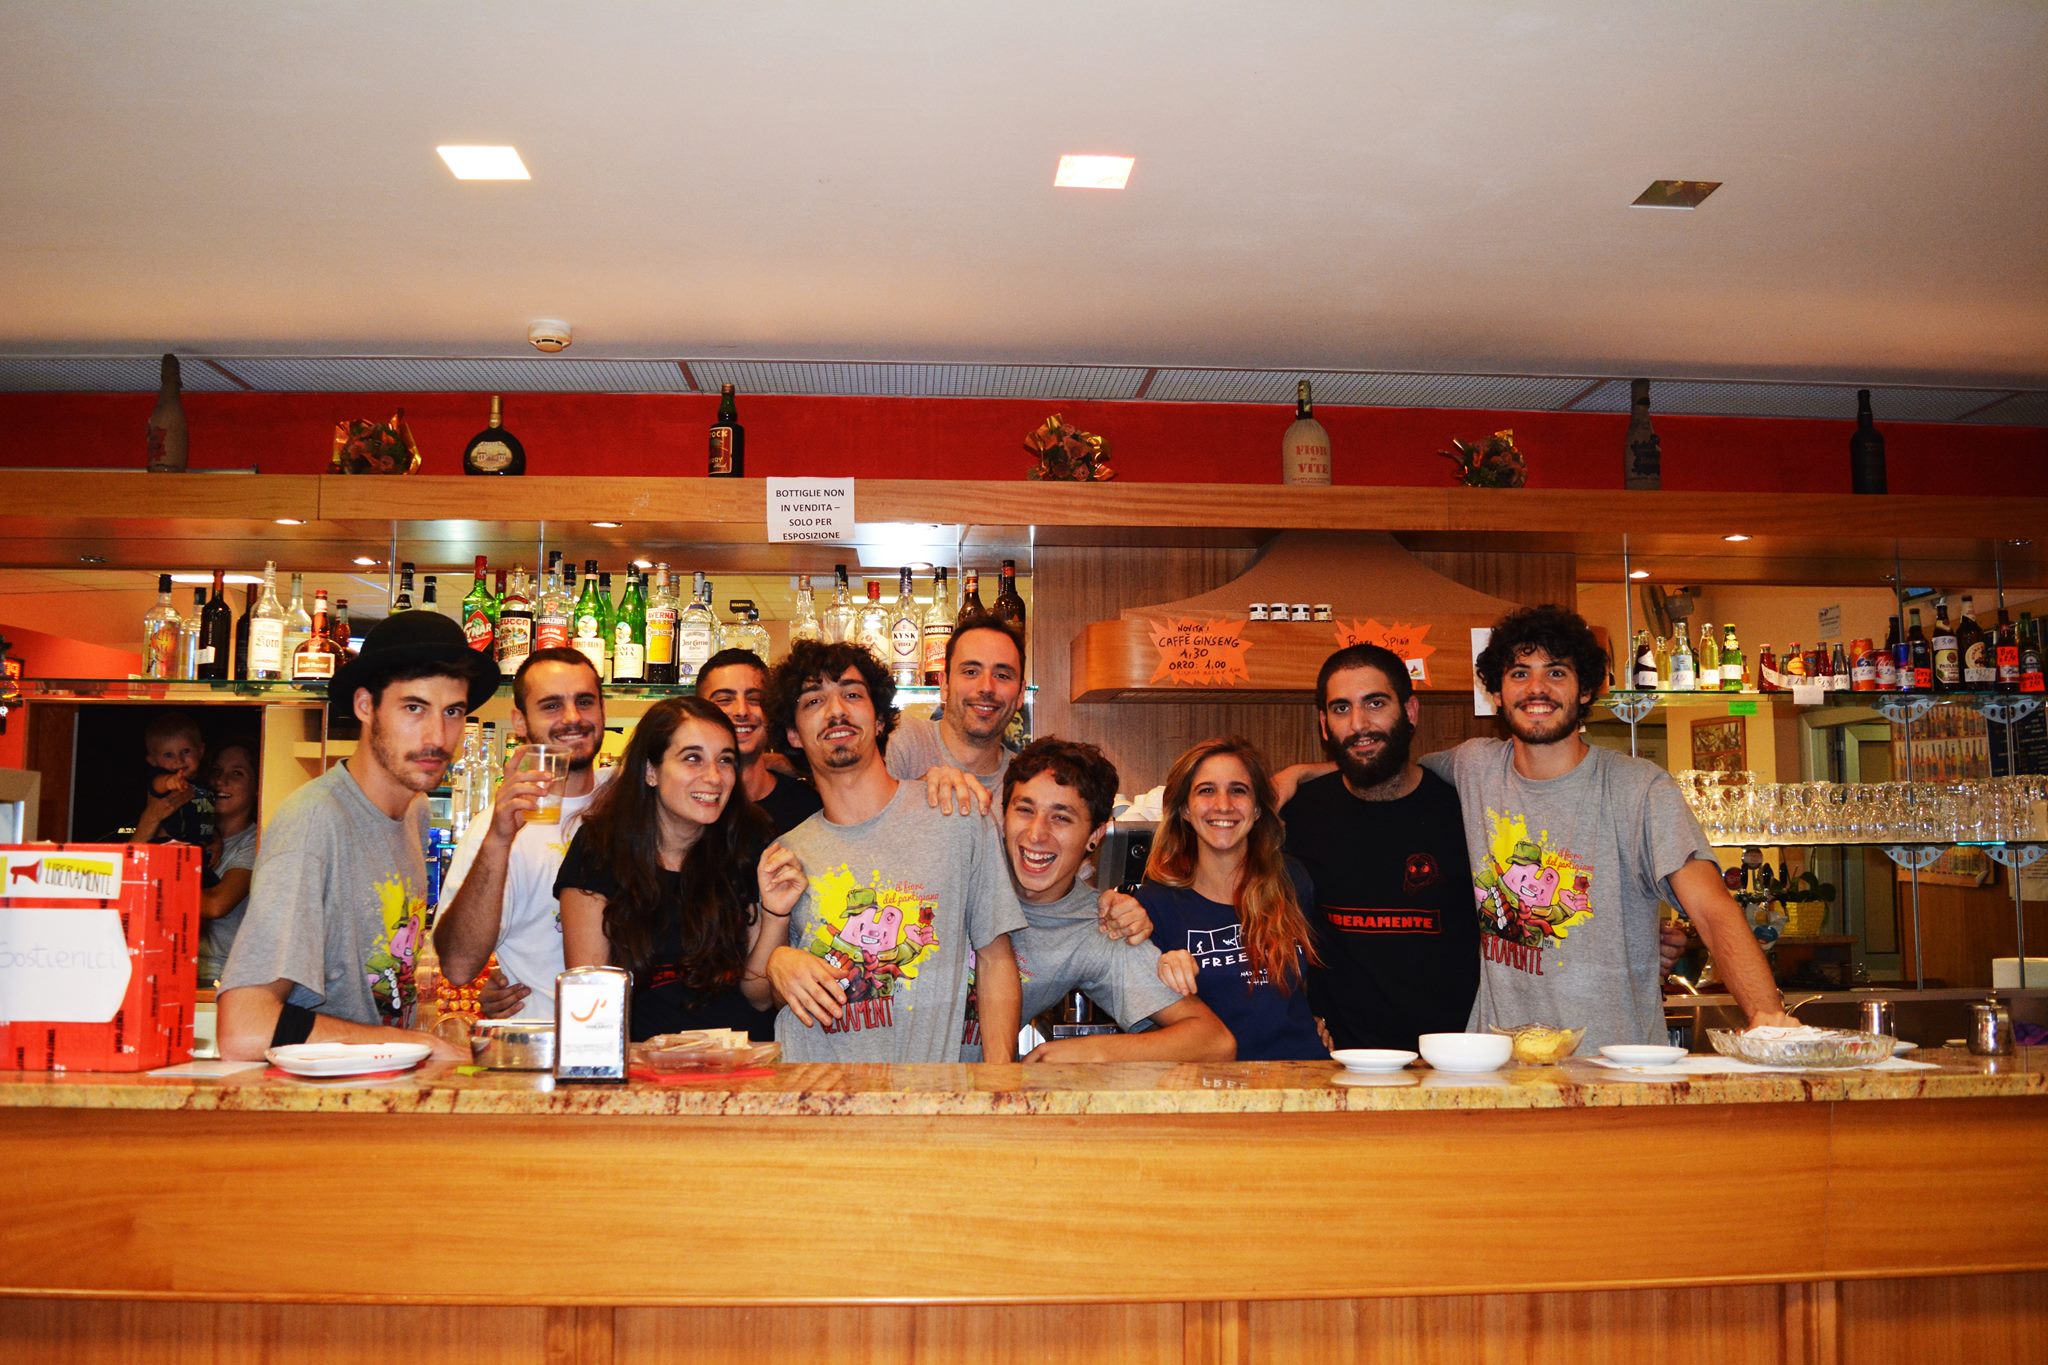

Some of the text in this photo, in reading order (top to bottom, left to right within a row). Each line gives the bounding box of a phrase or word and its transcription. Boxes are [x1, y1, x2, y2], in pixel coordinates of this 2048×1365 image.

[1296, 445, 1328, 456] FIOR
[1298, 463, 1329, 474] VITE
[775, 489, 845, 498] BOTTIGLIE NON
[780, 504, 791, 512] IN
[793, 504, 833, 512] VENDITA
[789, 518, 832, 527] SOLO PER
[782, 531, 840, 541] ESPOSIZIONE
[648, 611, 674, 620] AVERNA
[893, 632, 916, 640] KYSK
[1193, 635, 1240, 648] GINSENG
[1179, 647, 1209, 660] 1,30
[1204, 659, 1227, 669] 1,00
[45, 862, 112, 896] LIBERAMENTE
[883, 893, 897, 904] del
[1327, 913, 1433, 929] IBERAMENTE
